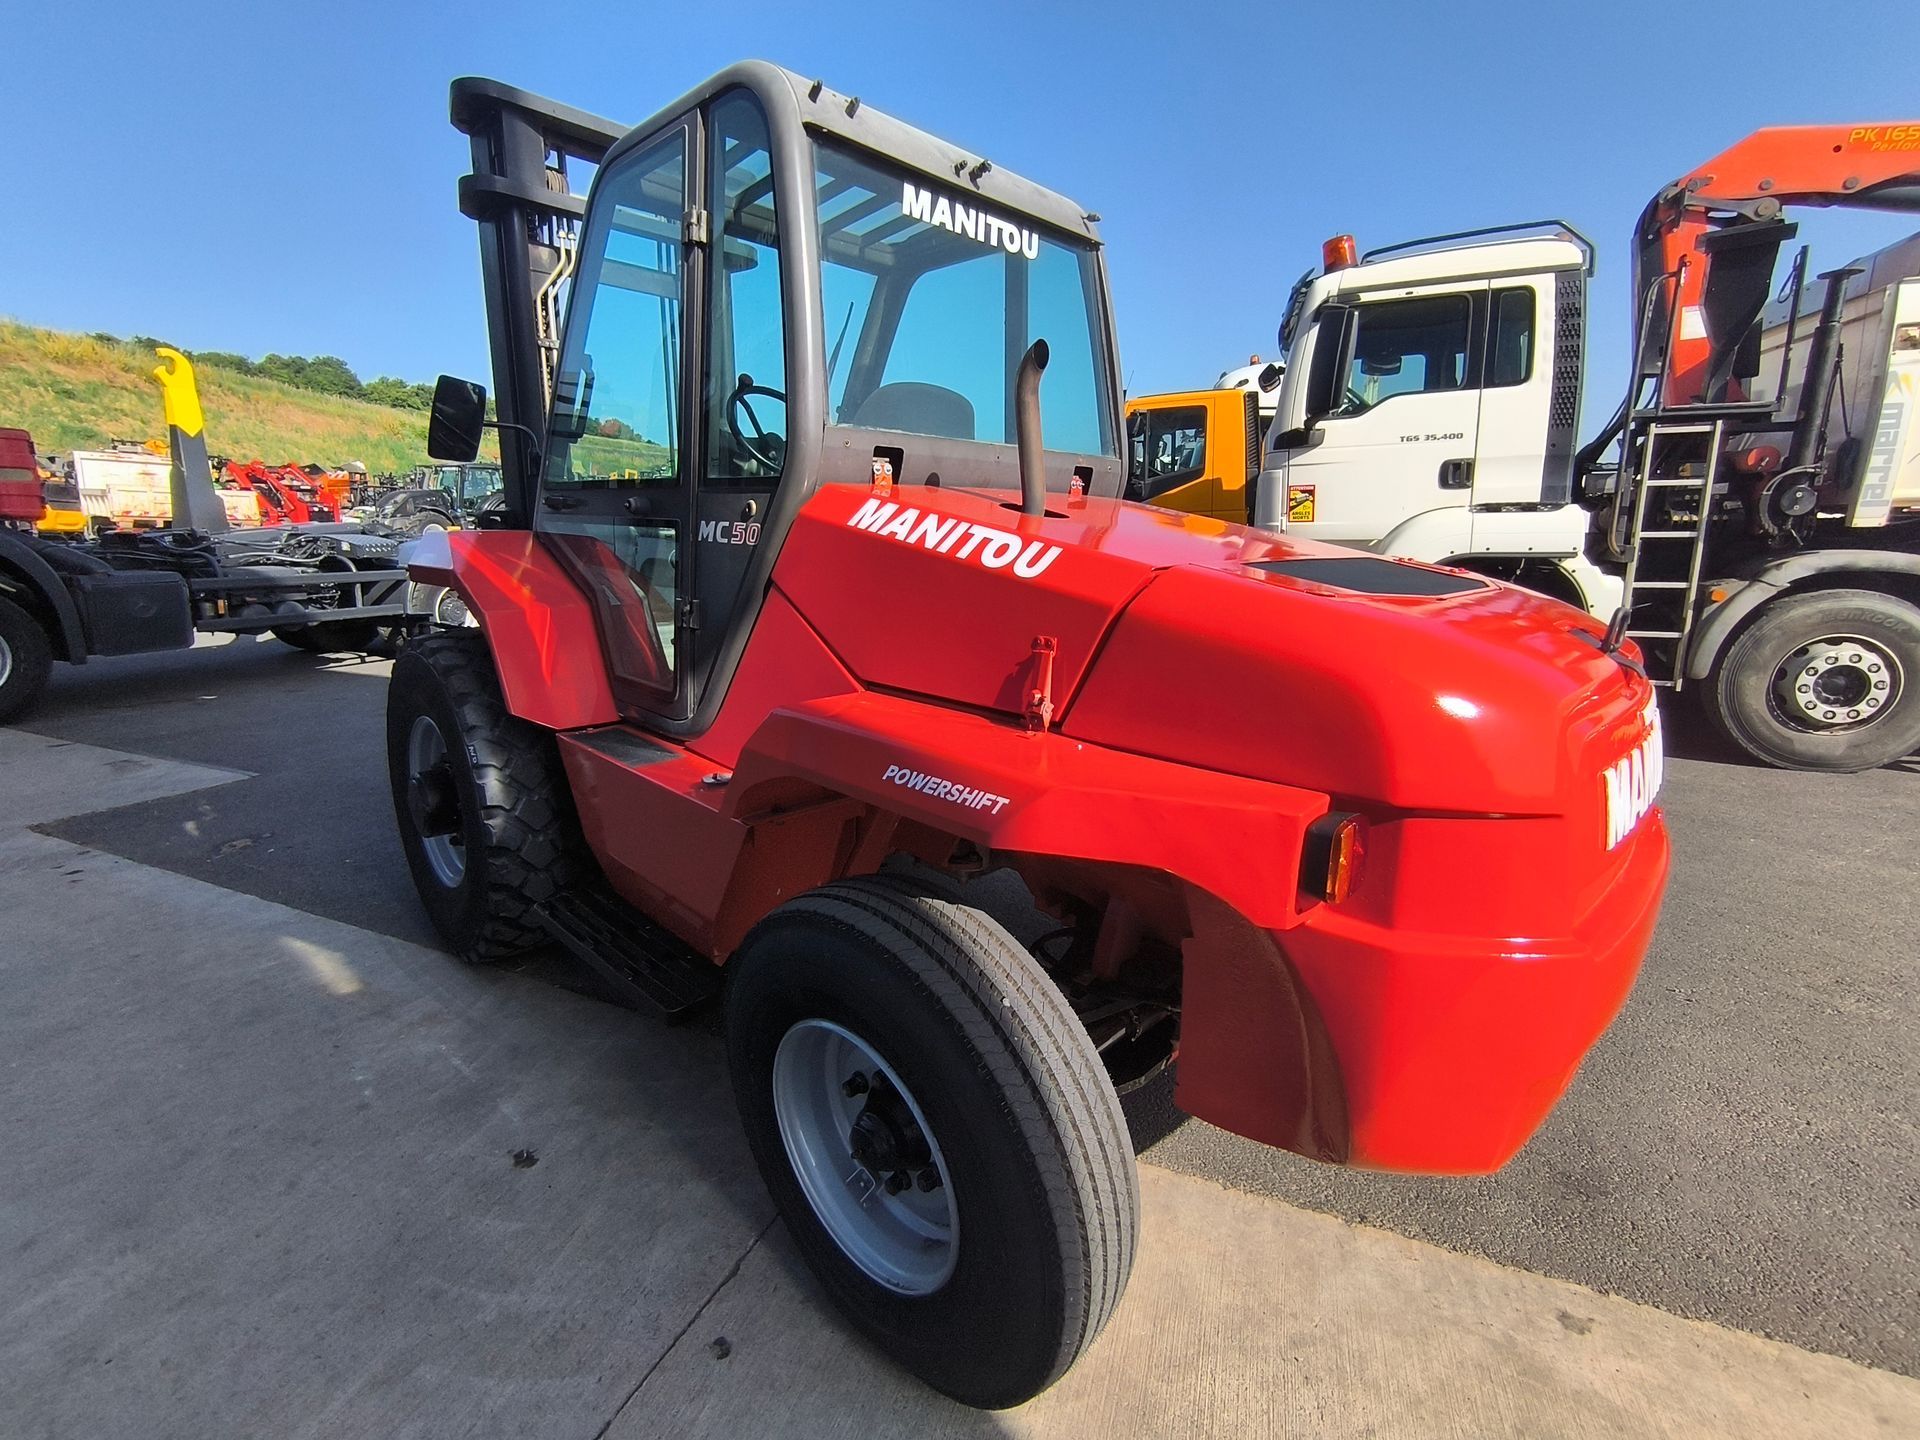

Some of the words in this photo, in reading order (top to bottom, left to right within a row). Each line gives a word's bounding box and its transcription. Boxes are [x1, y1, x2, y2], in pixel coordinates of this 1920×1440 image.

[1849, 128, 1880, 142] PK
[902, 182, 1040, 260] MANITOU
[1400, 434, 1420, 443] TGS
[1423, 432, 1464, 441] 35.400
[1860, 402, 1905, 508] marrel
[847, 498, 1064, 579] MANITOU
[882, 764, 1011, 815] POWERSHIFT
